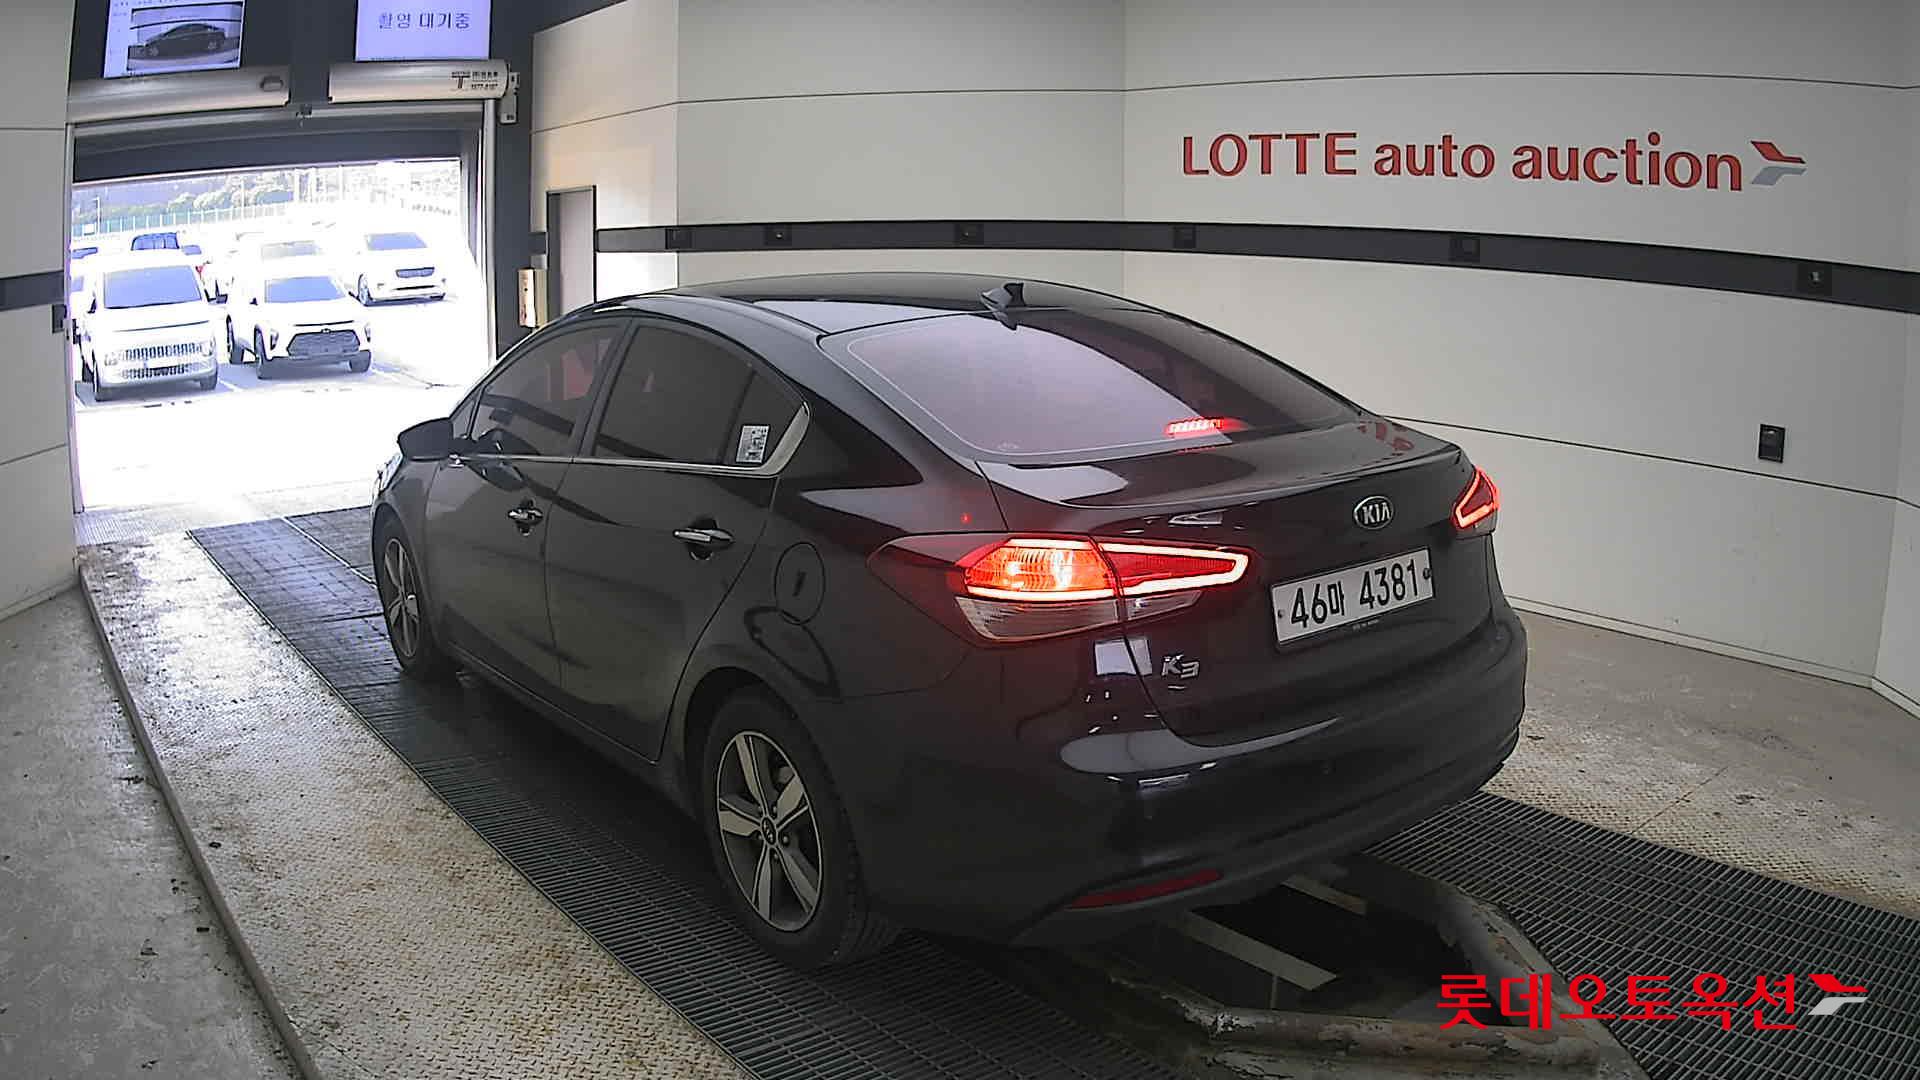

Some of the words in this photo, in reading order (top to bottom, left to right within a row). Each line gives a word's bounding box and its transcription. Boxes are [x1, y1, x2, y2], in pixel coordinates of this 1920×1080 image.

[419, 12, 470, 29] 대기중
[1183, 132, 1357, 176] LOTTE
[1373, 134, 1496, 178] auto
[1511, 131, 1742, 191] auction
[1362, 501, 1391, 525] KIA
[1290, 581, 1345, 628] 46마
[1359, 558, 1418, 610] 4381
[1161, 654, 1200, 679] K3
